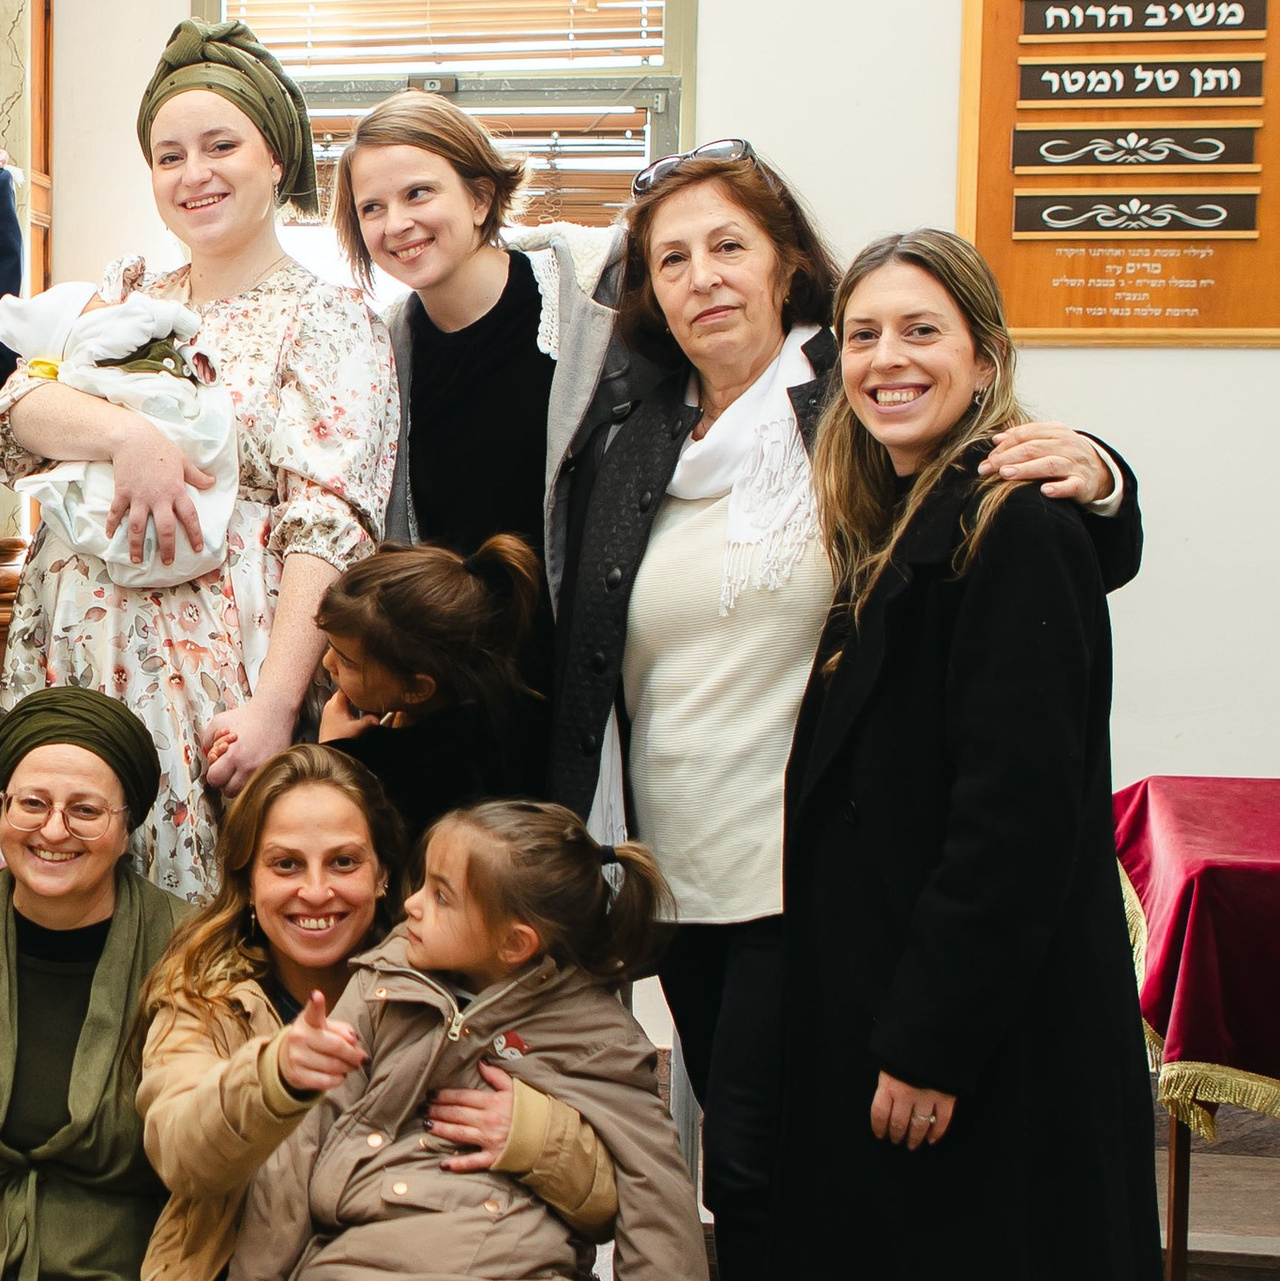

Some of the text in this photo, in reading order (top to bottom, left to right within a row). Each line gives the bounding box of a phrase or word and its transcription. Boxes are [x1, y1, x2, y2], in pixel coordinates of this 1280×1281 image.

[1046, 3, 1244, 28] משיב הרוח
[1041, 65, 1241, 96] ותן טל ומטר
[1055, 248, 1086, 258] היקרה
[1153, 248, 1181, 257] נשמת
[1126, 262, 1162, 274] מרים
[1165, 308, 1199, 317] תרומת
